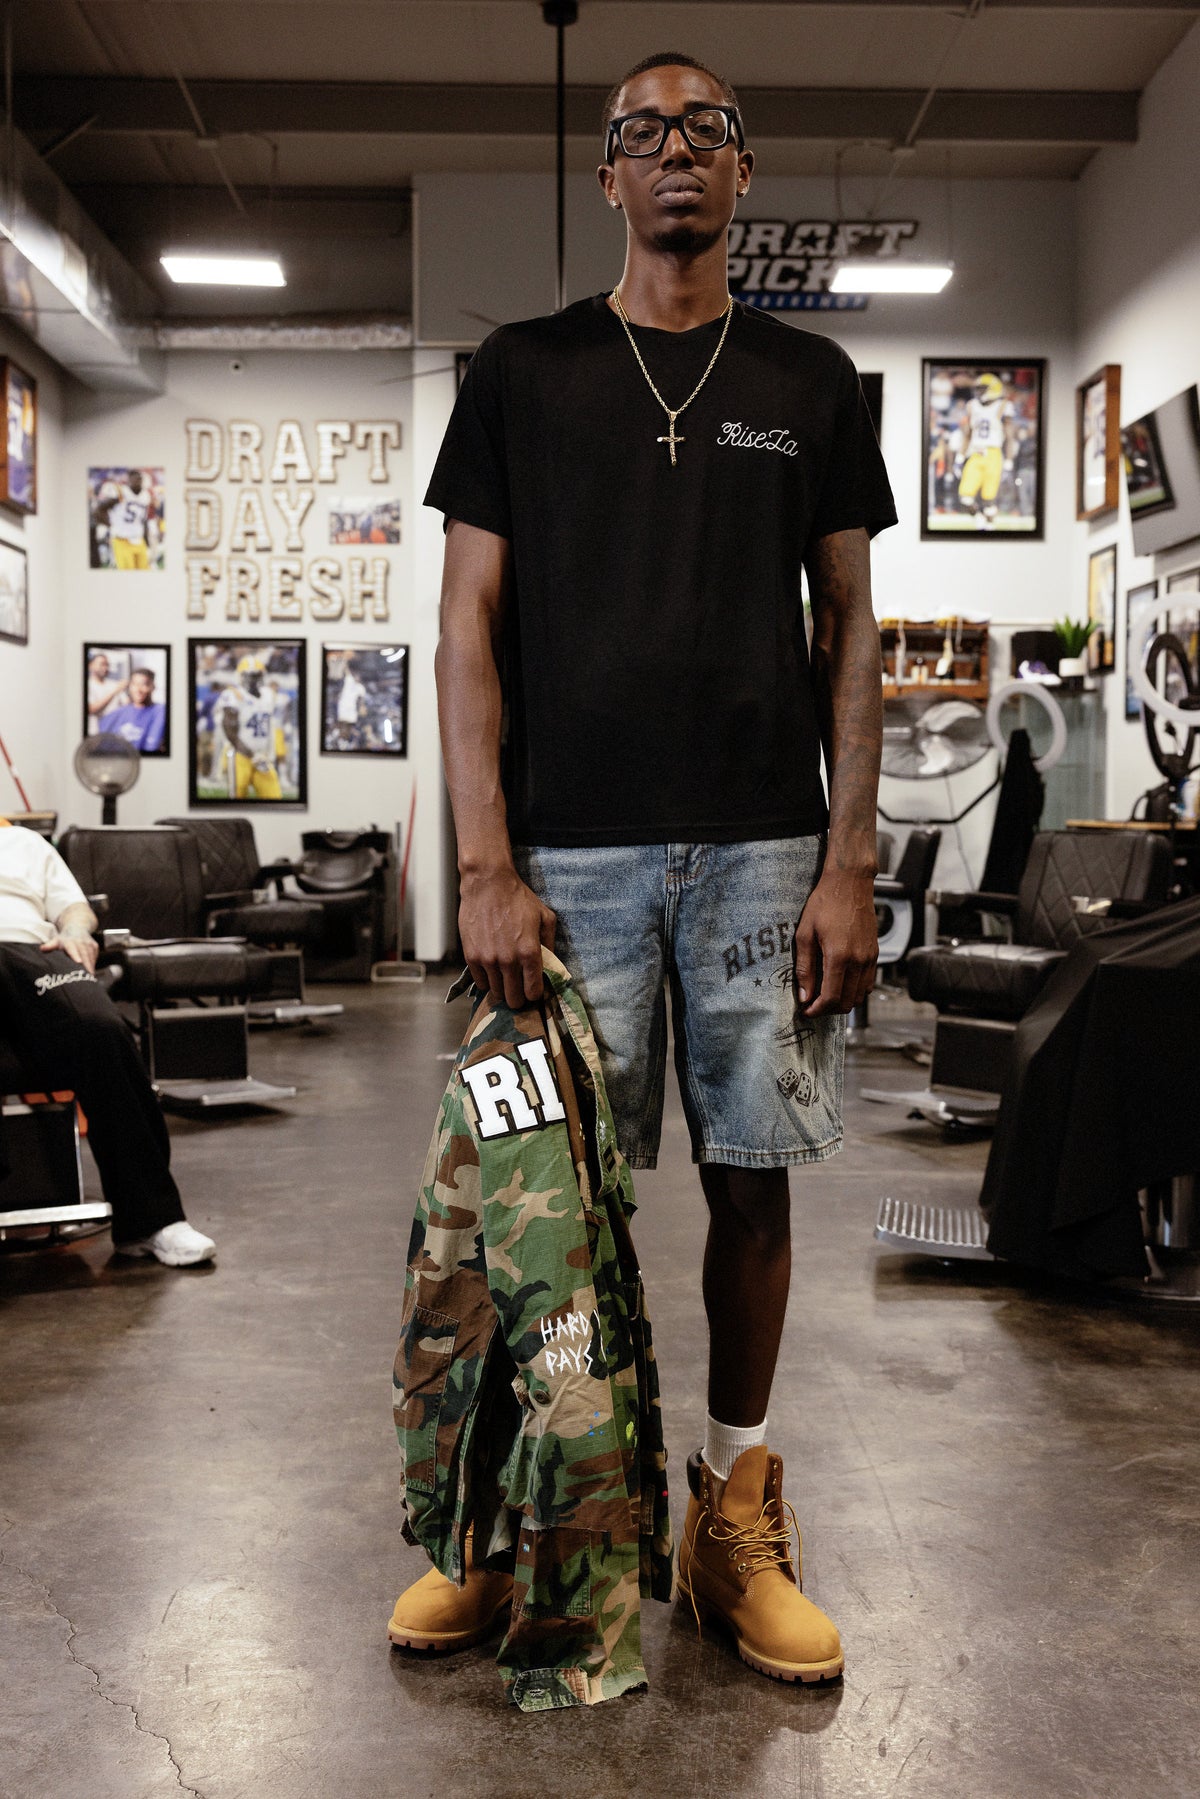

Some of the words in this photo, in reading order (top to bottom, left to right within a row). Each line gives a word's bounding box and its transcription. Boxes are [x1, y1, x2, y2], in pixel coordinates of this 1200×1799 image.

[186, 420, 402, 483] DRAFT
[185, 488, 315, 551] DAY
[185, 556, 389, 623] FRESH
[723, 922, 797, 983] RISE
[460, 1037, 567, 1140] RI
[540, 1310, 590, 1345] HARD
[545, 1340, 594, 1377] PAYS
